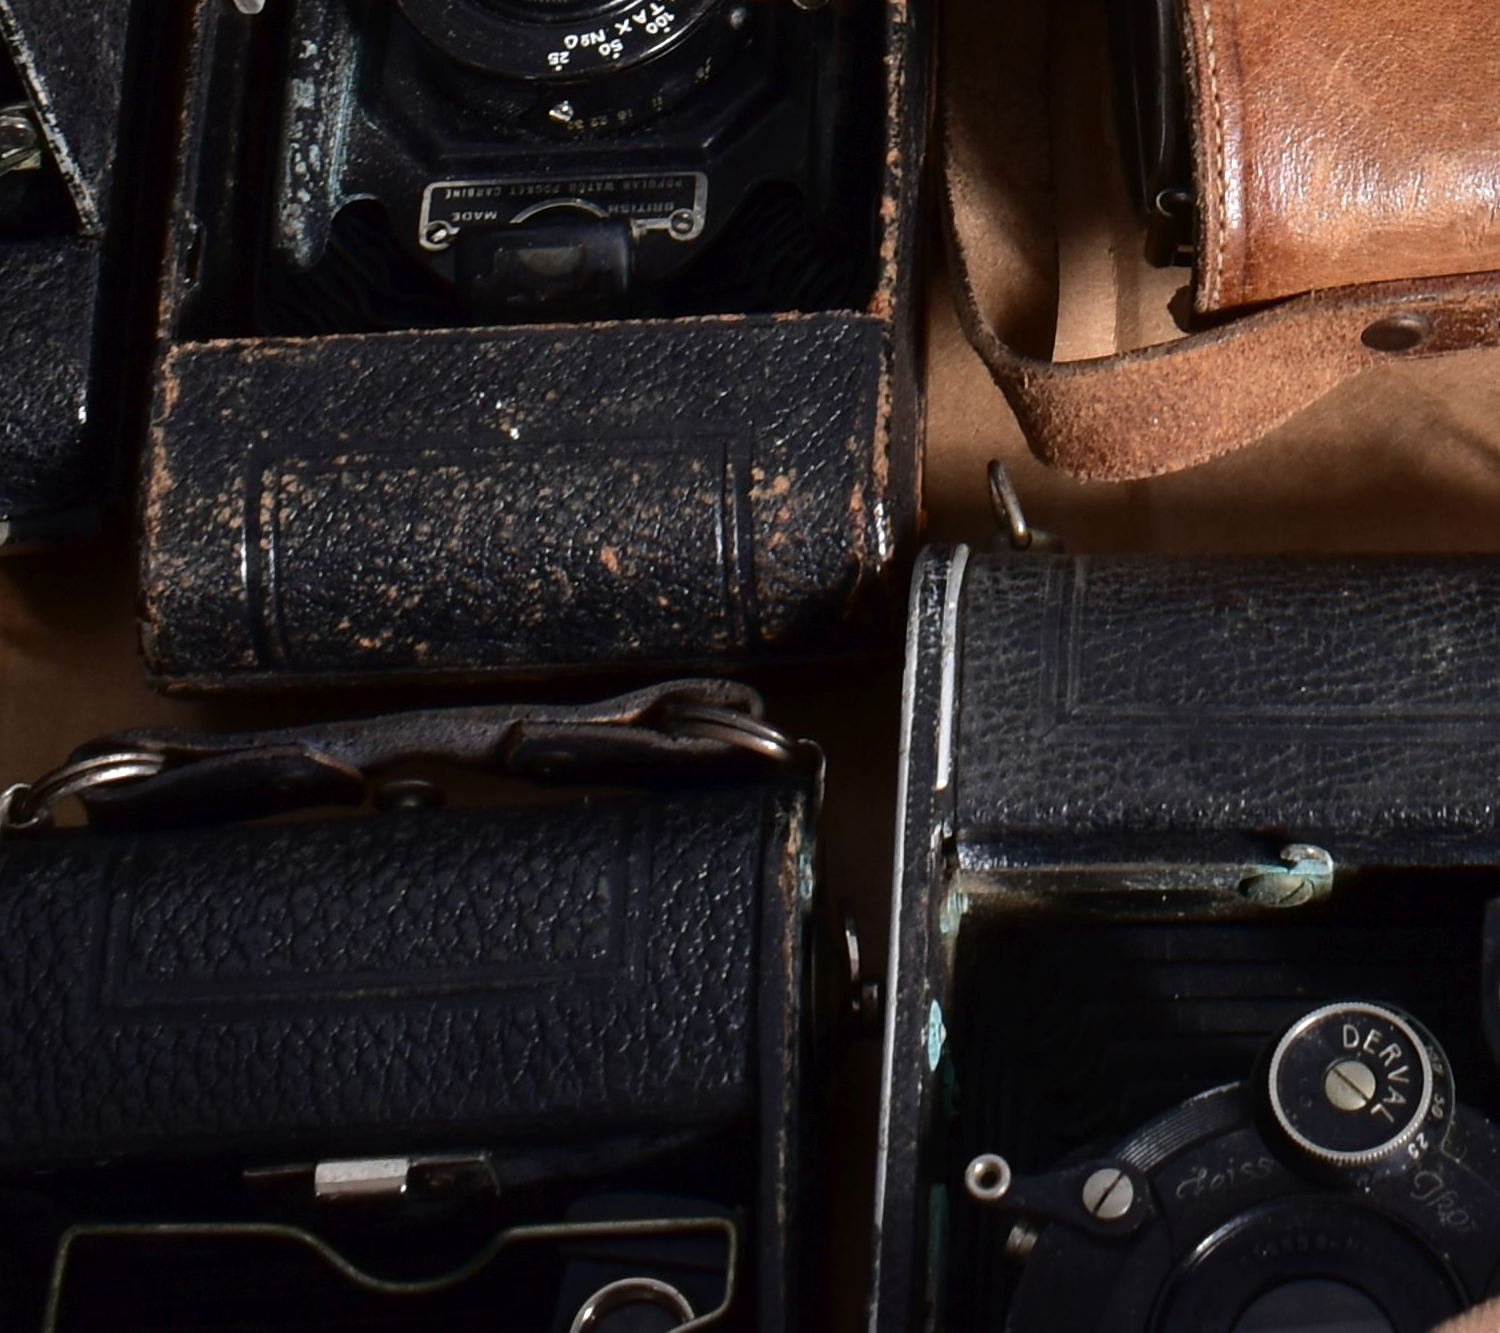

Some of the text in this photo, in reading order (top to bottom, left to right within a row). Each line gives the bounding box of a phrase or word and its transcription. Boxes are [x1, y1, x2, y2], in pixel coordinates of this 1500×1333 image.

[644, 11, 676, 35] 100
[598, 37, 624, 58] 50
[547, 51, 572, 68] 25
[444, 186, 502, 200] CARBINE
[451, 209, 499, 223] MADE
[1342, 1023, 1411, 1124] DERVAL
